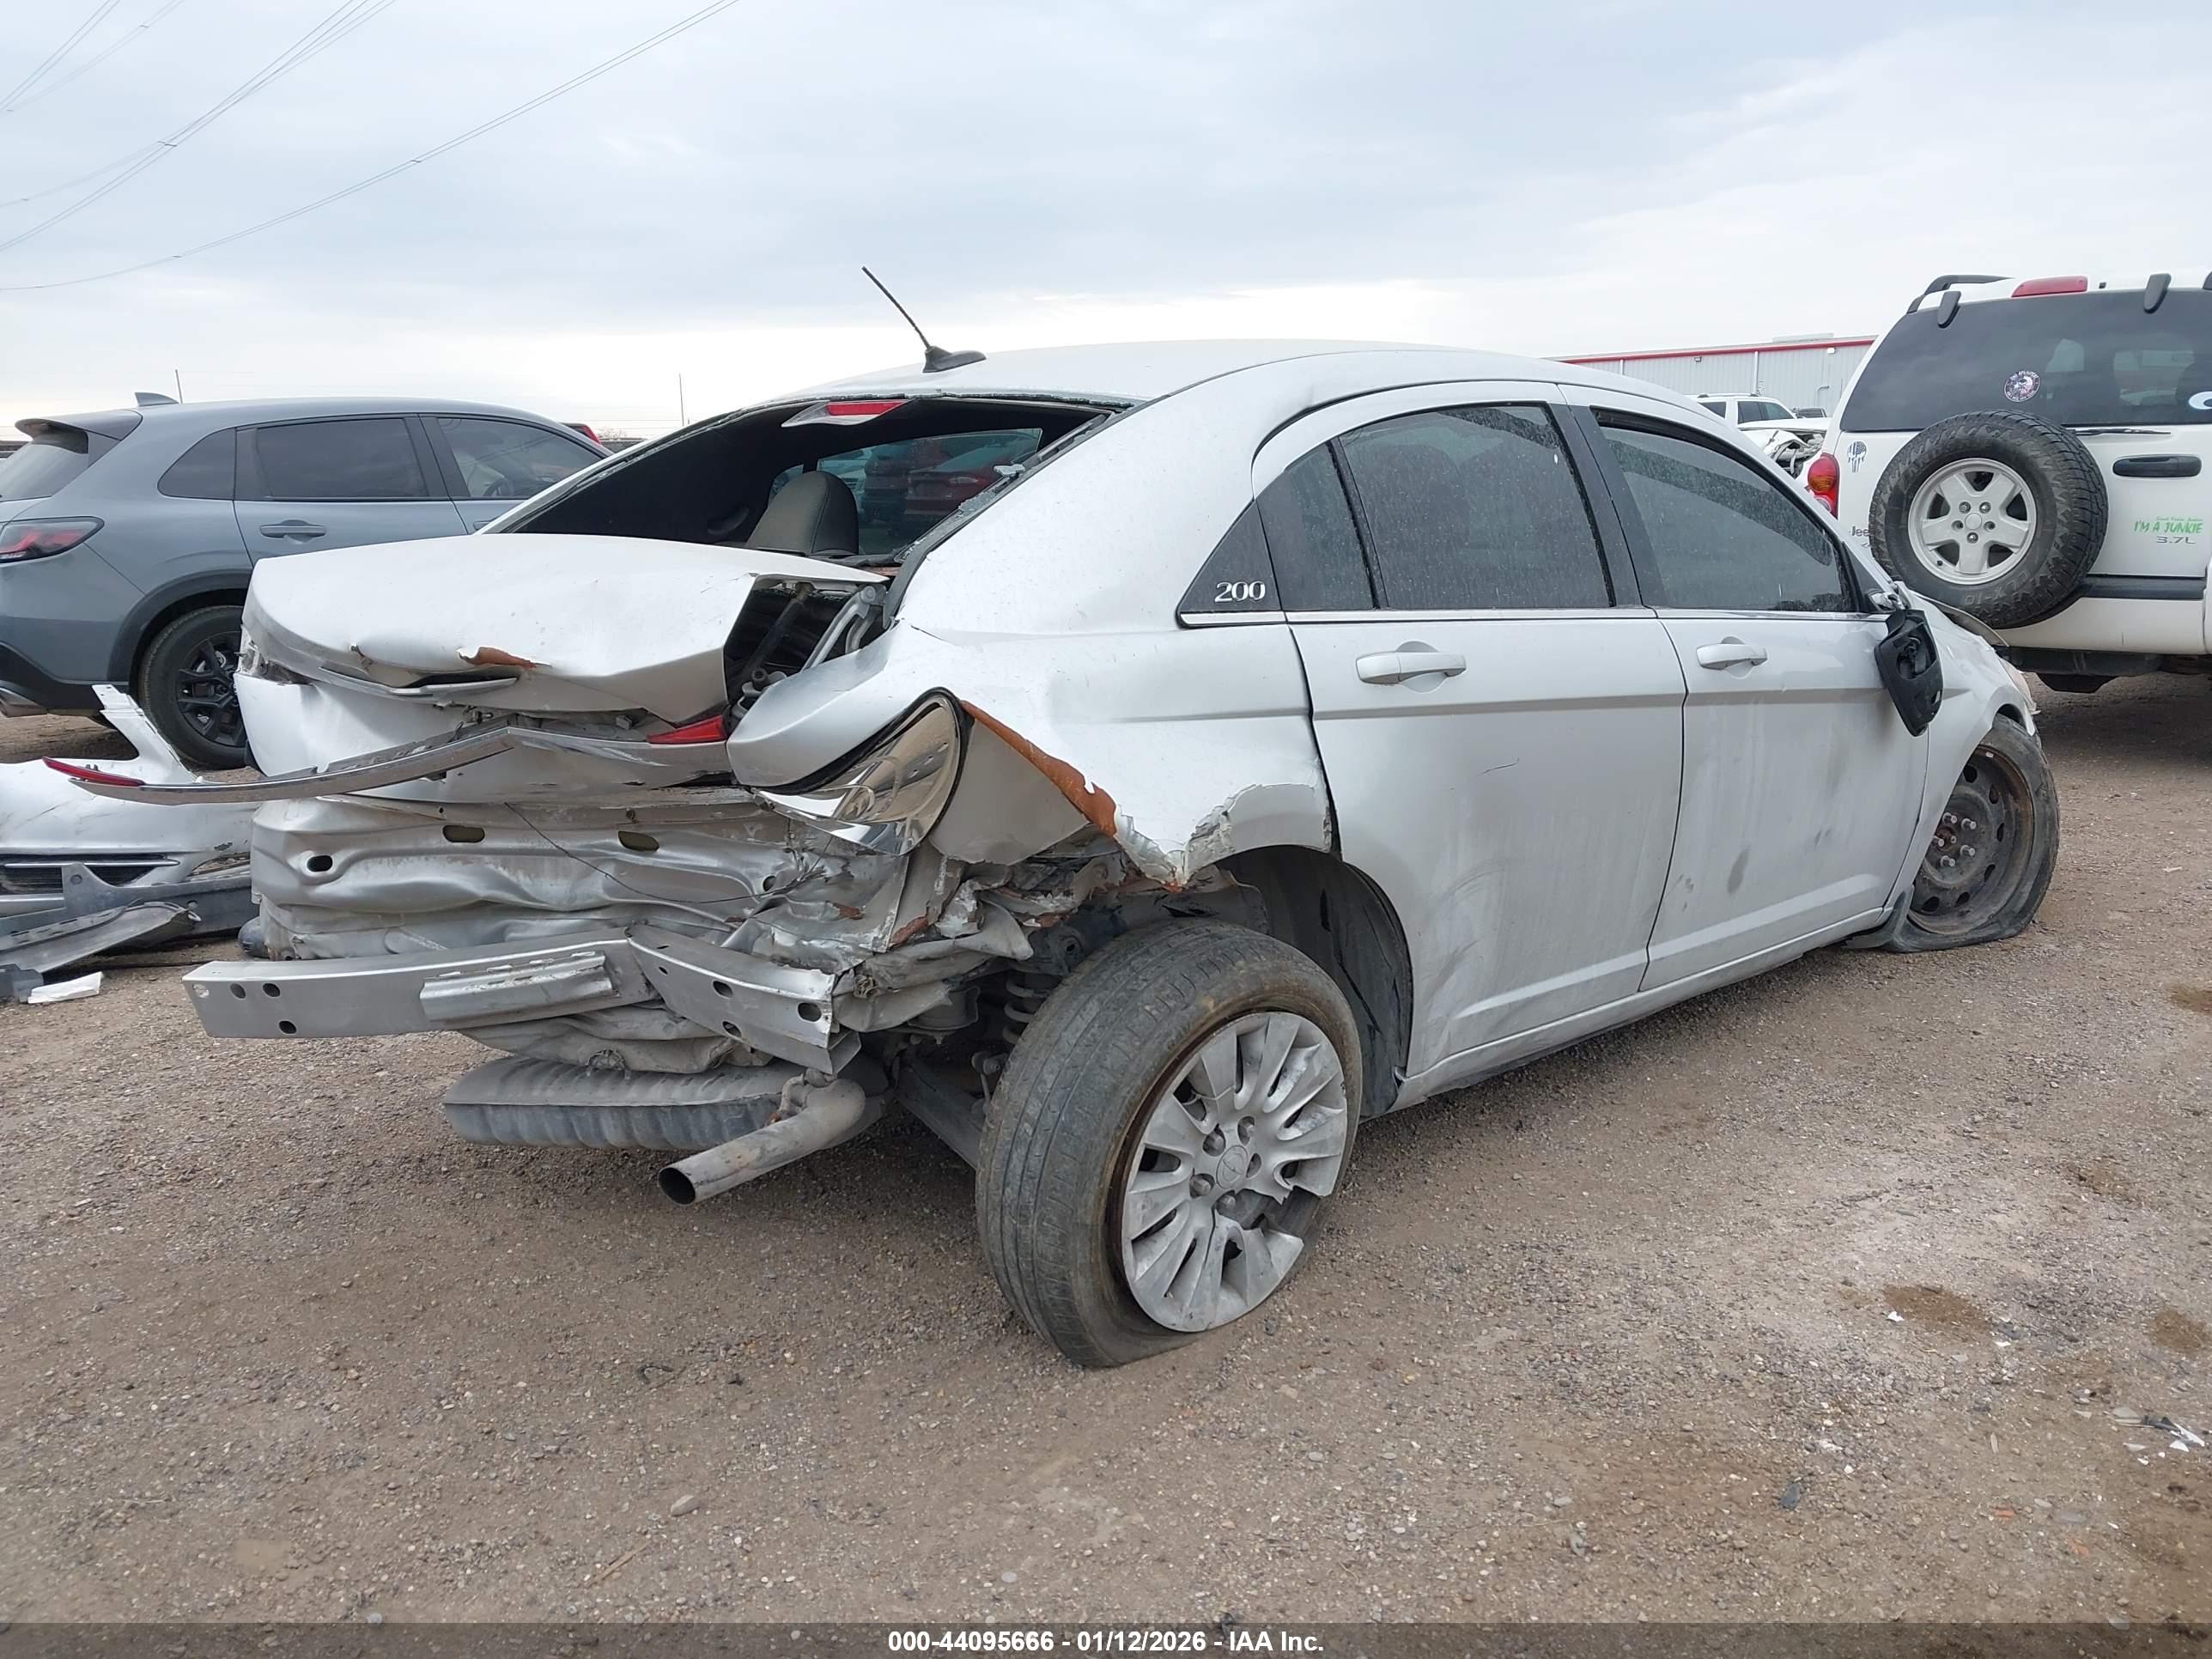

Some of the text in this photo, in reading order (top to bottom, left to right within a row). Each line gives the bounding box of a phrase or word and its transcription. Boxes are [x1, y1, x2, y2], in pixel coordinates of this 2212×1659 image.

[1848, 525, 1869, 538] Jee
[2153, 521, 2160, 532] A
[2164, 521, 2203, 533] JUNKIE
[2156, 535, 2197, 544] 3.7L
[1214, 580, 1266, 603] 200
